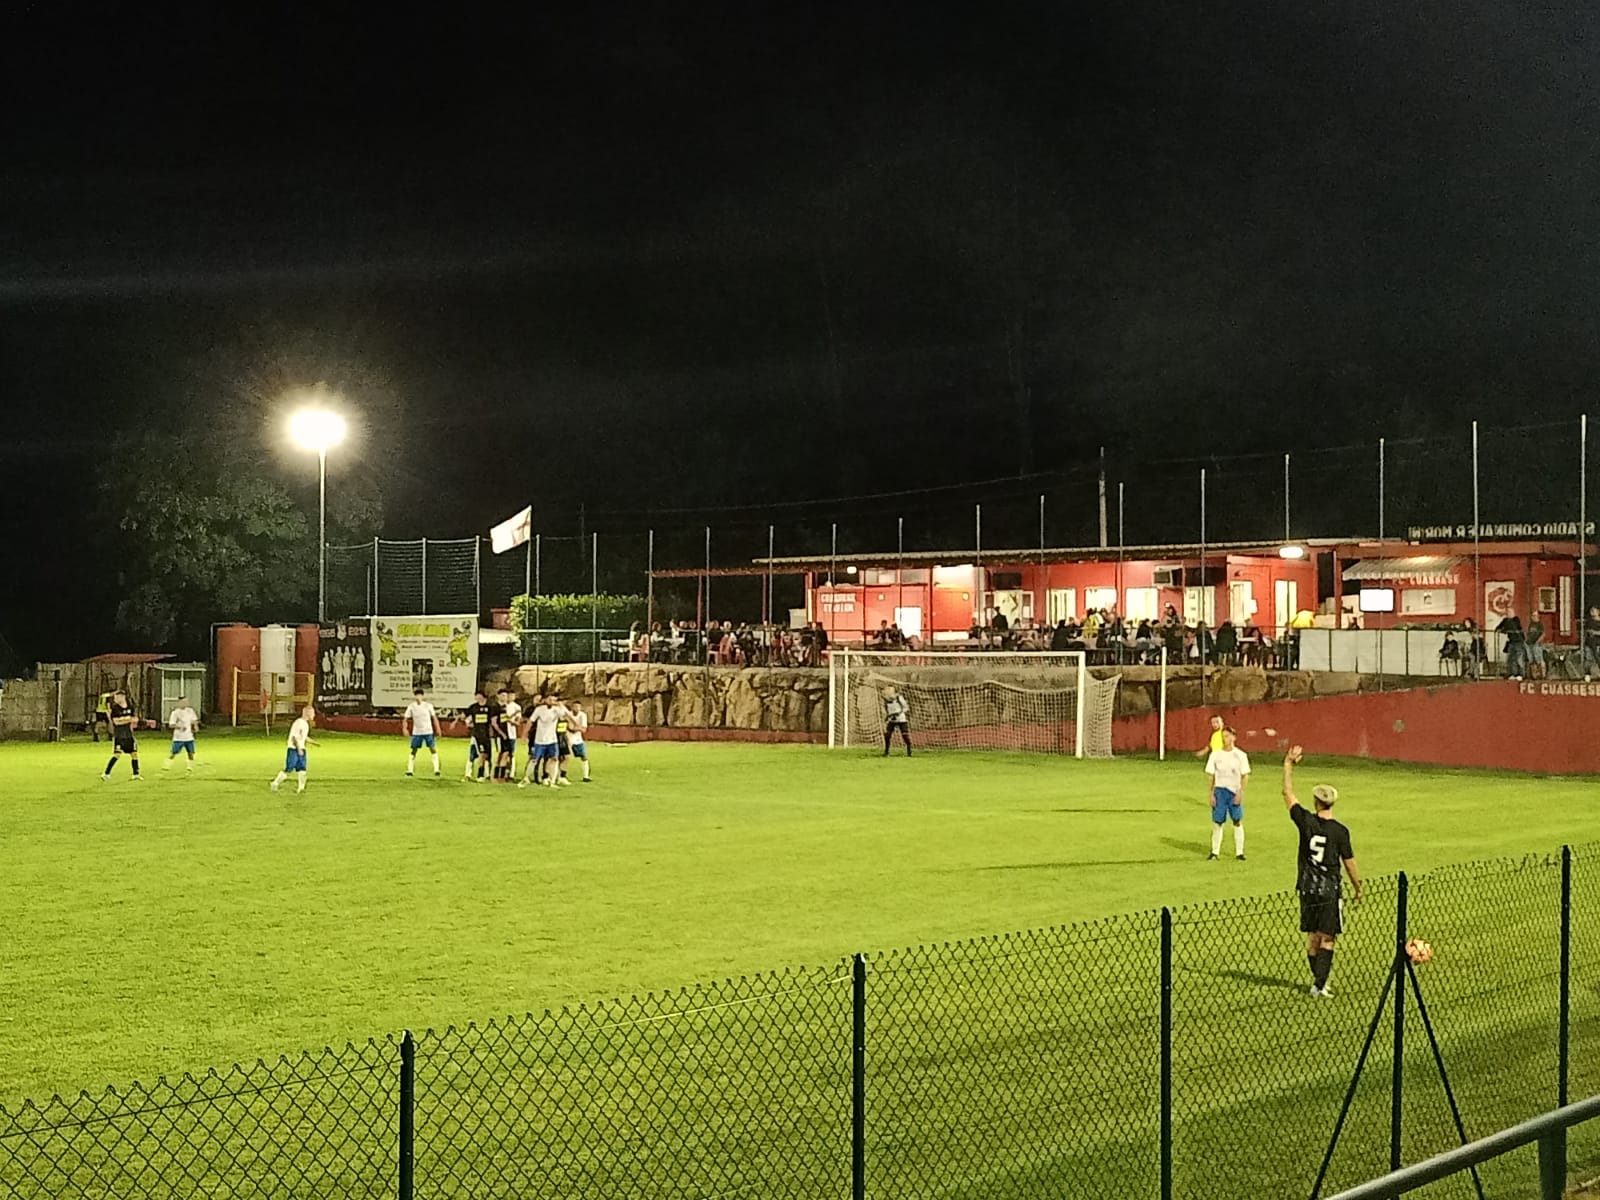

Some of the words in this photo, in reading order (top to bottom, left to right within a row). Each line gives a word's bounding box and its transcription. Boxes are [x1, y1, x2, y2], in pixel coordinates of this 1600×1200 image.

[1519, 682, 1535, 694] FC
[1541, 683, 1600, 696] CUASSESE
[1309, 834, 1327, 863] 5
